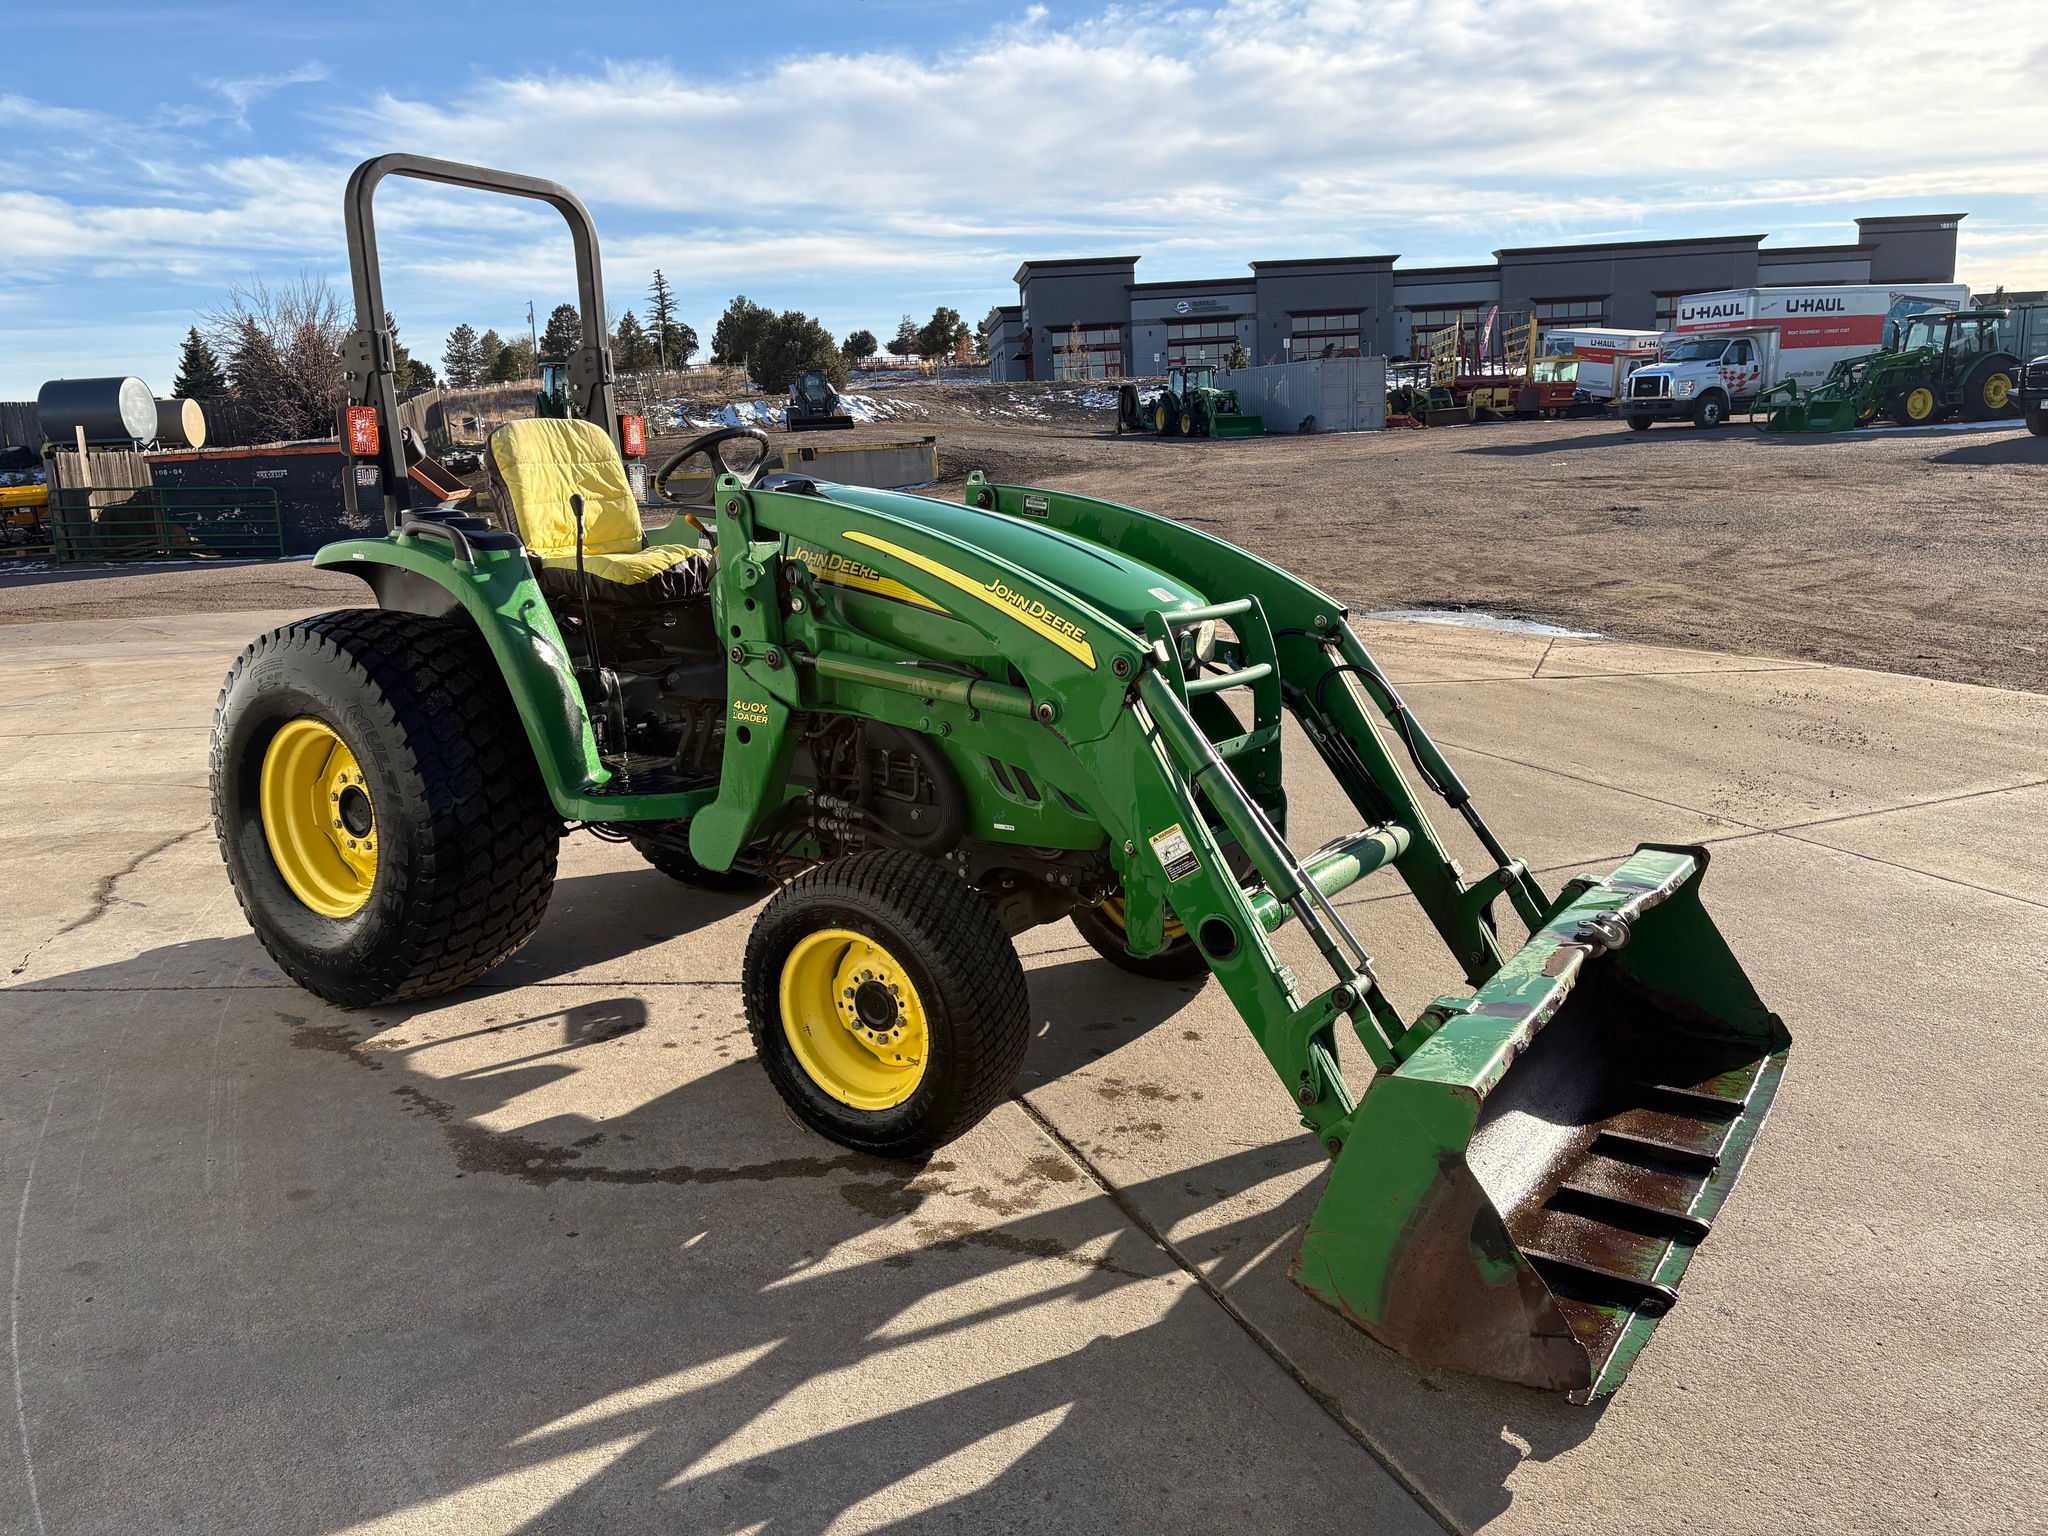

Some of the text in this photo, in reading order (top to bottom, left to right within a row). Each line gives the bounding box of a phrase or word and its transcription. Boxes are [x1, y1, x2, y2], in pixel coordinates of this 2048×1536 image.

[1681, 303, 1745, 321] U-HAUL
[1786, 298, 1845, 313] U-HAUL
[1590, 339, 1616, 348] U-HAUL
[1785, 370, 1814, 379] Gentle-Ride
[790, 546, 880, 580] JOHN DEERE
[984, 578, 1087, 642] JOHN DEERE
[733, 700, 768, 714] 400X
[732, 711, 768, 725] LOADER
[347, 703, 403, 807] MULTI
[1158, 826, 1178, 838] WARNING
